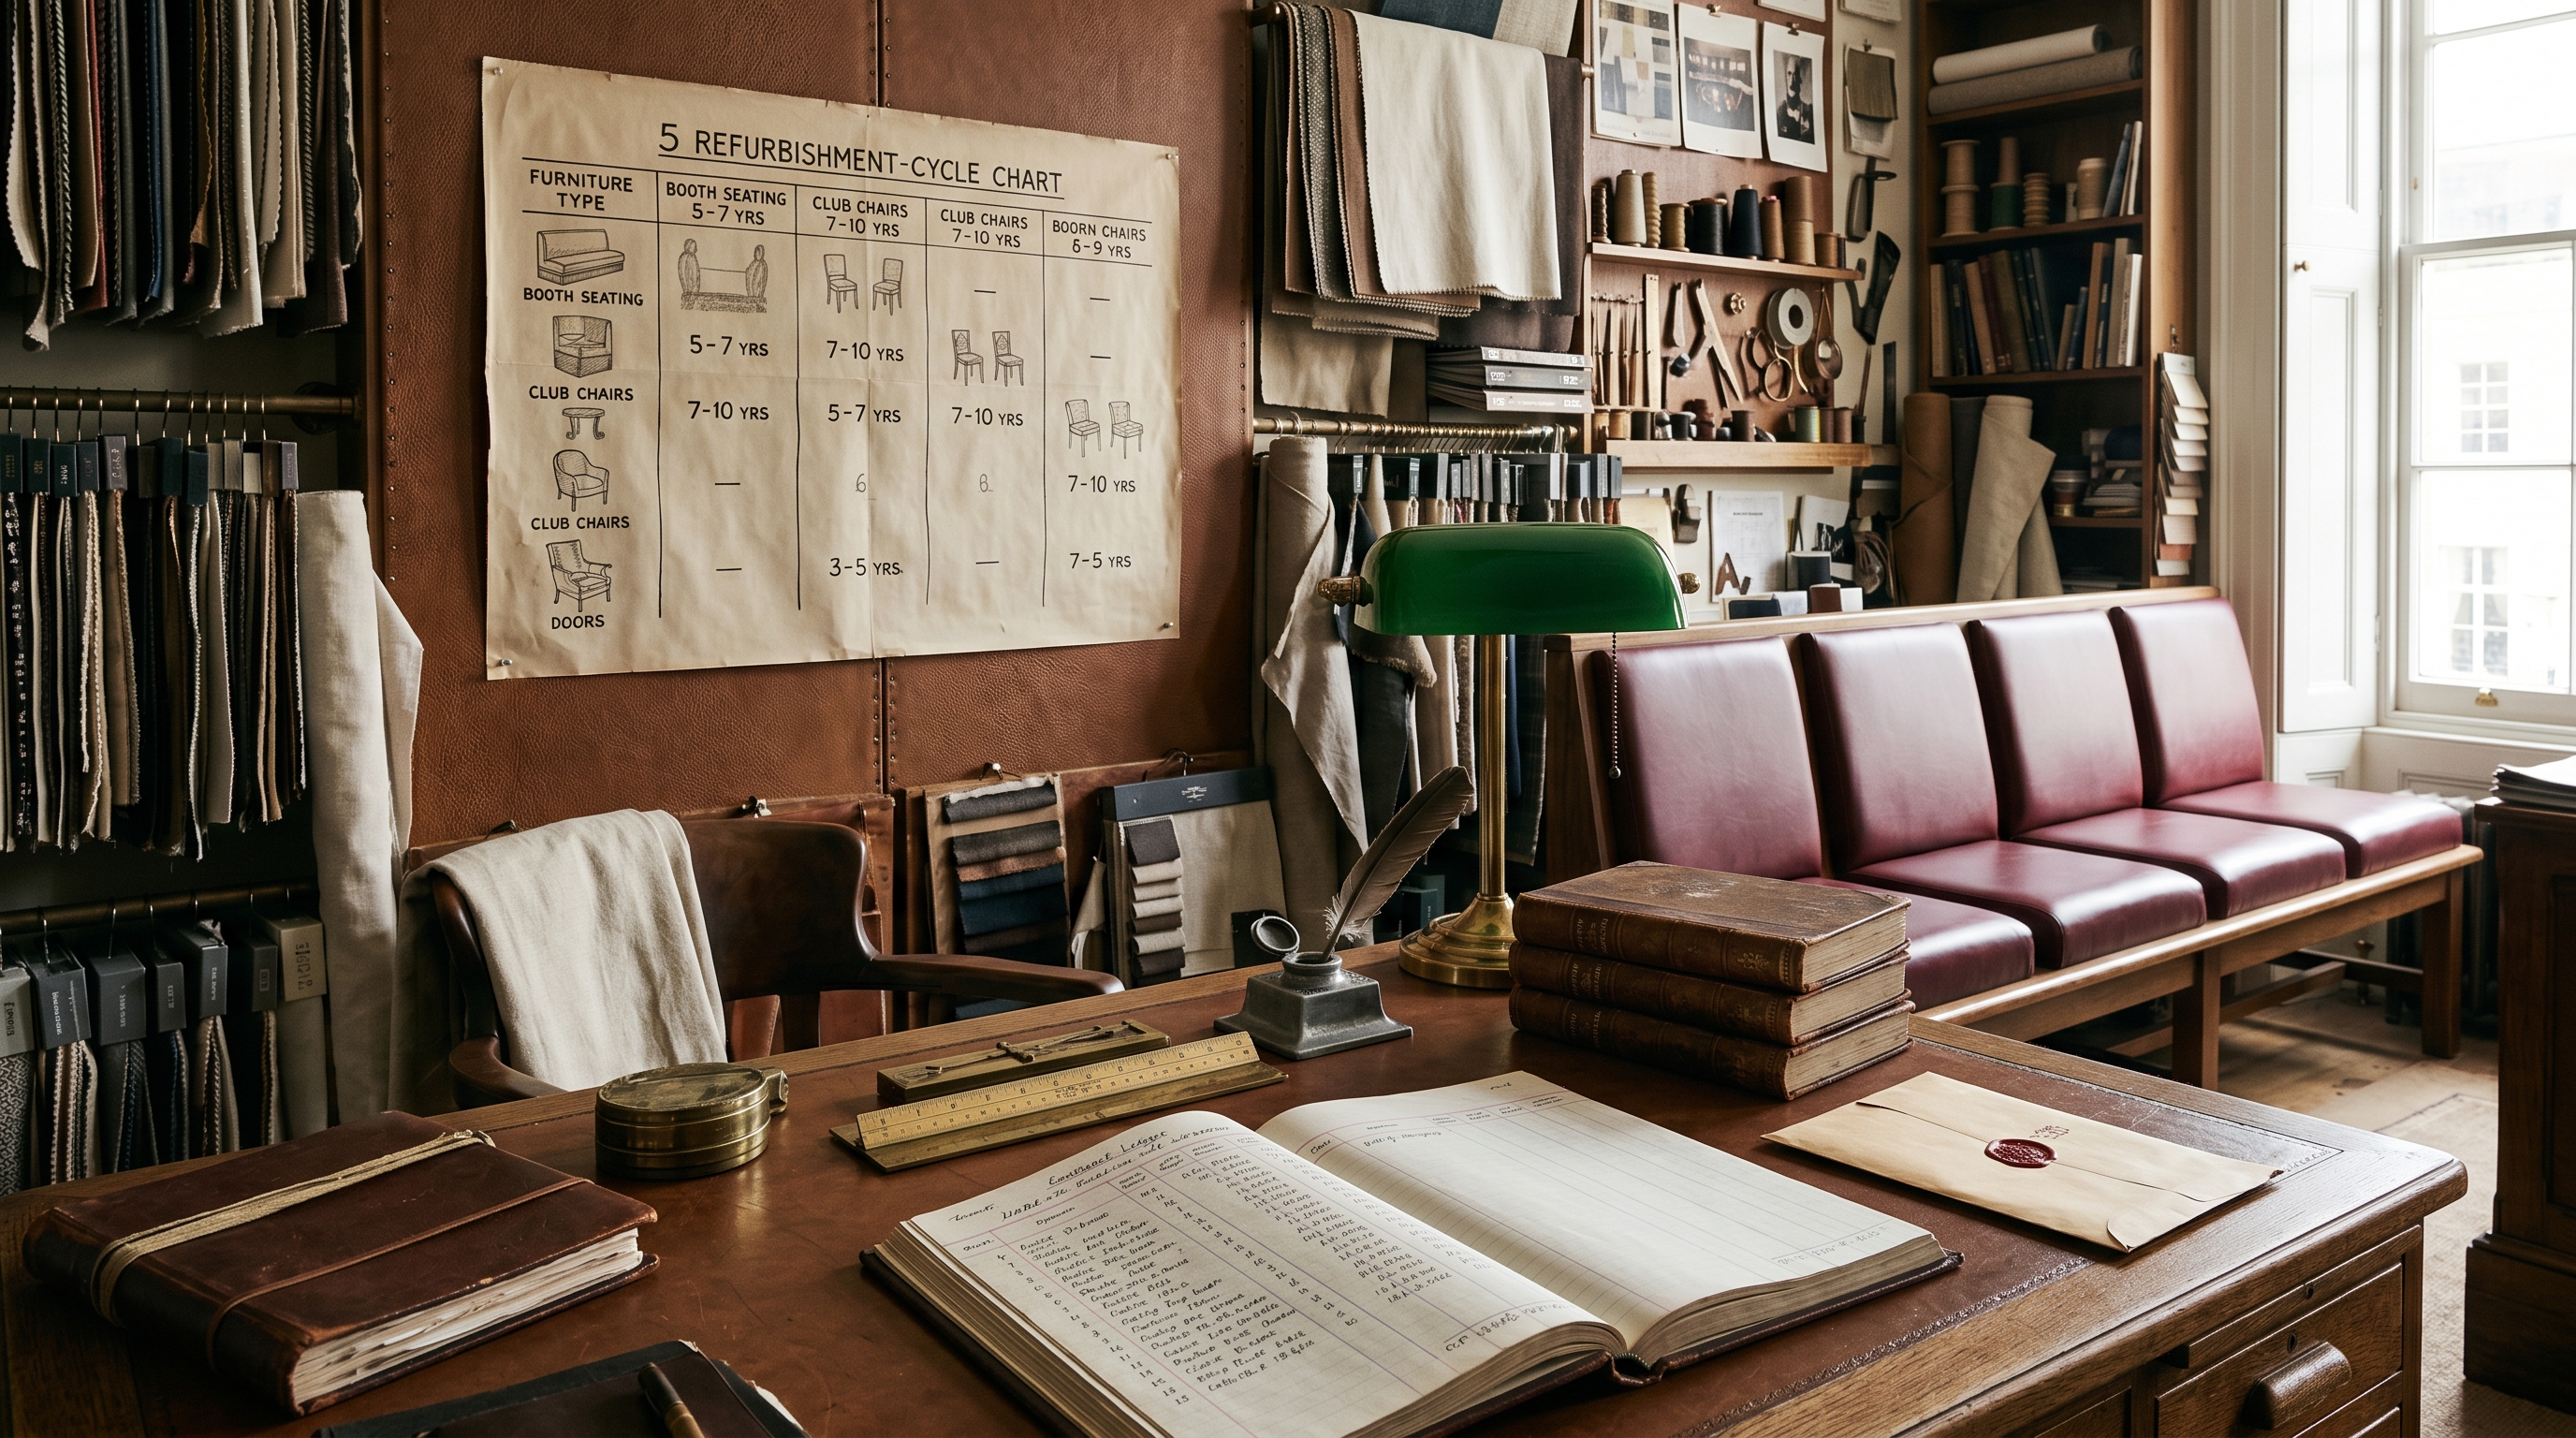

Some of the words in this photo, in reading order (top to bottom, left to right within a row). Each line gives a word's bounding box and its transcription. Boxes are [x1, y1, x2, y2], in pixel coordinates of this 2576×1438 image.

[658, 122, 680, 153] 5
[694, 129, 980, 184] REFURBISHMENT-CYCLE
[992, 166, 1062, 194] CHART
[530, 169, 634, 193] FURNITURE
[559, 193, 606, 212] TYPE
[666, 182, 717, 200] BOOTH
[724, 185, 786, 206] SEATING
[692, 202, 729, 223] 5-7
[734, 209, 765, 226] YRS
[812, 196, 852, 213] CLUB
[856, 199, 909, 218] CHAIRS
[826, 215, 867, 235] 7-10
[872, 222, 900, 238] YRS
[940, 208, 975, 226] CLUB
[980, 213, 1029, 230] CHAIRS
[952, 227, 990, 245] 7-10
[995, 233, 1021, 248] YRS
[1052, 219, 1096, 237] BOORN
[1102, 225, 1147, 242] CHAIRS
[1107, 244, 1132, 259] YRS
[523, 286, 574, 302] BOOTH
[580, 290, 644, 307] SEATING
[690, 334, 733, 356] 5-7
[739, 342, 769, 357] YRS
[826, 340, 871, 360] 7-10
[876, 347, 904, 362] YRS
[528, 385, 570, 400] CLUB
[577, 387, 635, 402] CHAIRS
[687, 400, 734, 420] 7-10
[739, 406, 769, 421] YRS
[827, 404, 867, 422] 5-7
[872, 409, 901, 423] YRS
[951, 406, 993, 426] 7-10
[998, 413, 1024, 427] YRS
[1067, 475, 1107, 493] 7-10
[1113, 479, 1136, 493] YRS
[531, 517, 570, 531] CLUB
[576, 515, 630, 530] CHAIRS
[828, 557, 867, 578] 3-5
[1069, 551, 1103, 569] 7-5
[1107, 555, 1132, 568] YRS
[551, 614, 606, 630] DOORS
